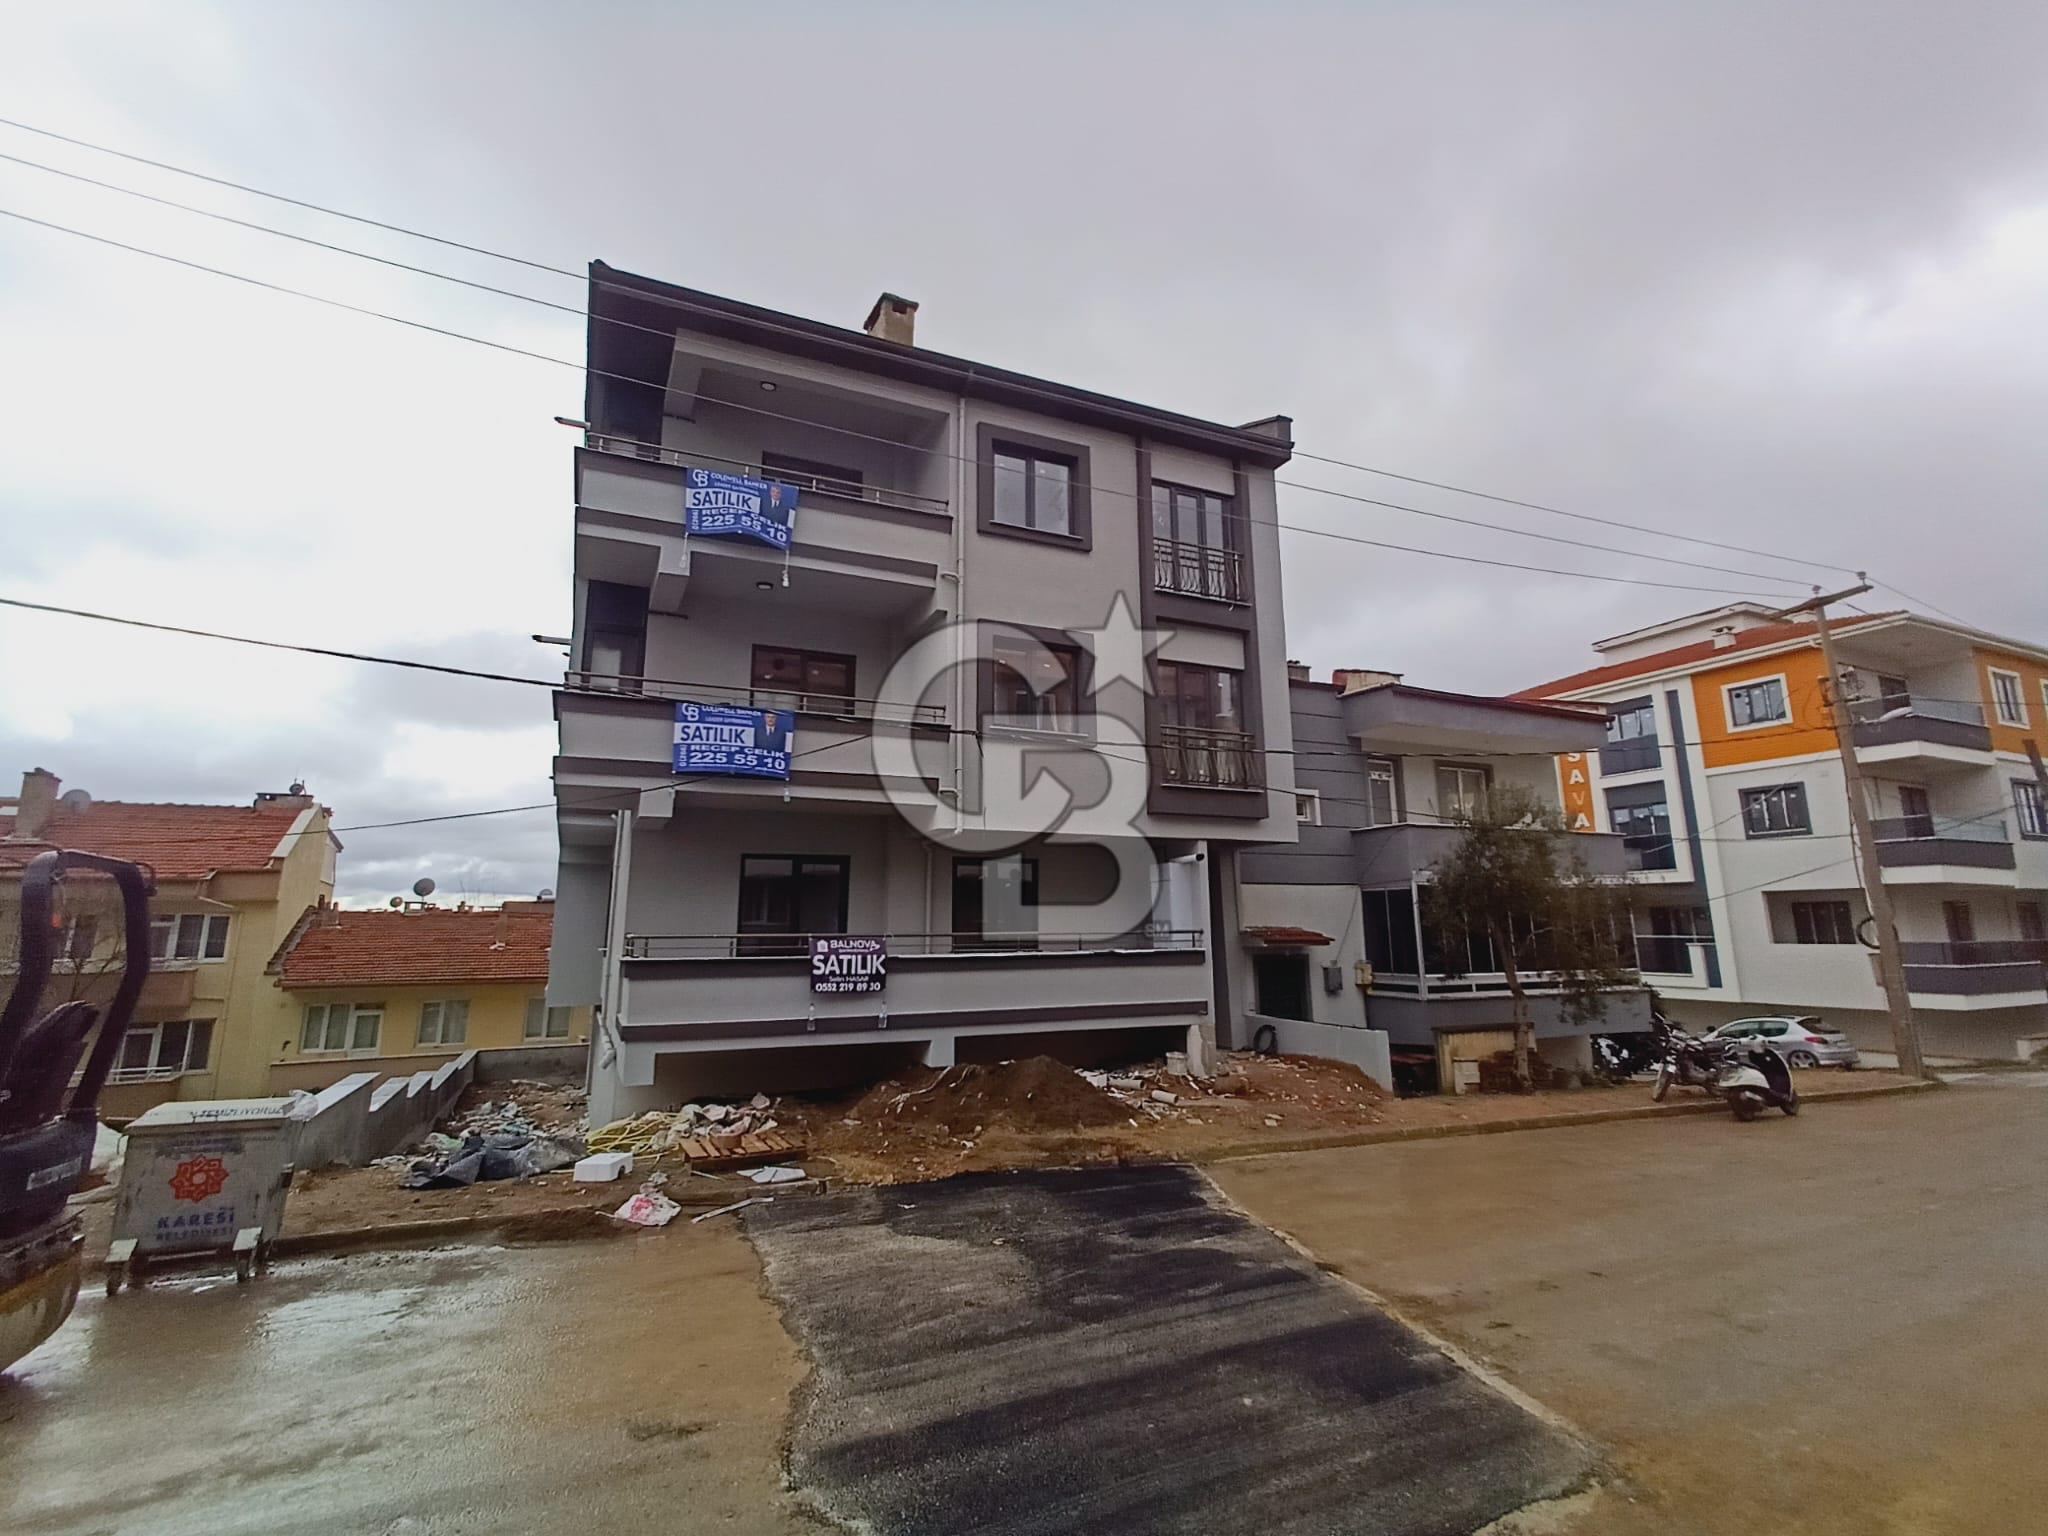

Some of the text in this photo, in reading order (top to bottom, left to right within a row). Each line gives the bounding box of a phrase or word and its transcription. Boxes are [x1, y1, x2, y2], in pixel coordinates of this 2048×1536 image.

[692, 490, 752, 510] SATILIK
[702, 514, 788, 542] 225 55 10
[681, 725, 746, 745] SATILIK
[690, 744, 740, 752] RECEP
[690, 752, 786, 770] 225 55 10
[830, 940, 878, 951] BALNOVA
[812, 954, 886, 975] SATILIK
[838, 983, 854, 991] 219
